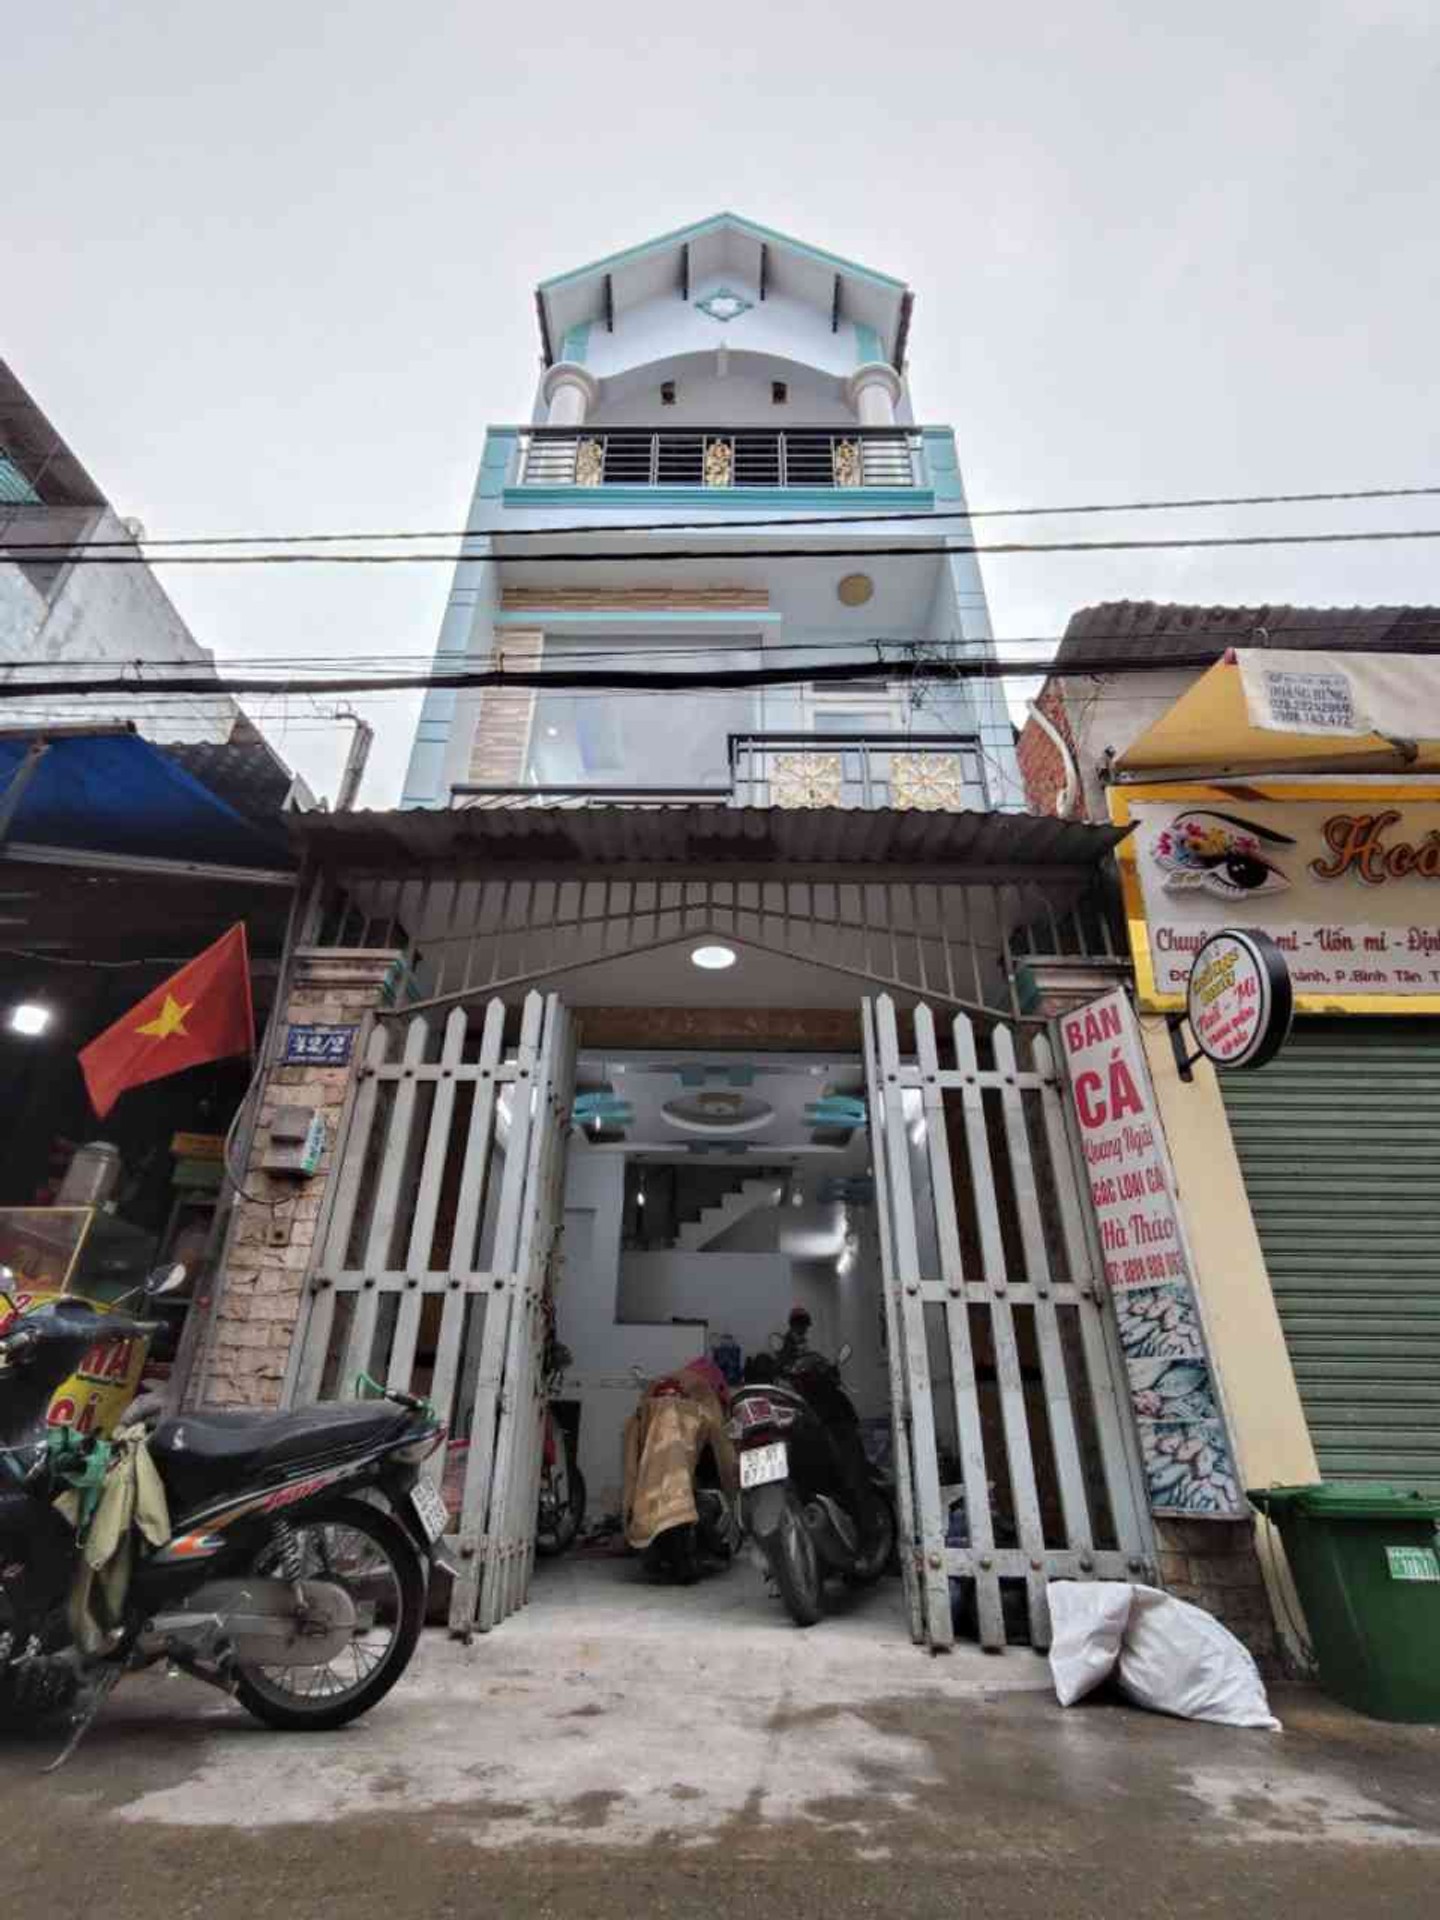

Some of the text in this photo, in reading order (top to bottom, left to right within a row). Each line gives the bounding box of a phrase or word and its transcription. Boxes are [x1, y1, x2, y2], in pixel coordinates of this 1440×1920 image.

[1156, 927, 1208, 953] Chuyê
[1364, 930, 1388, 952] mi
[1065, 1005, 1122, 1054] BÁN
[1075, 1047, 1144, 1129] CÁ
[1102, 1218, 1128, 1250] Hà
